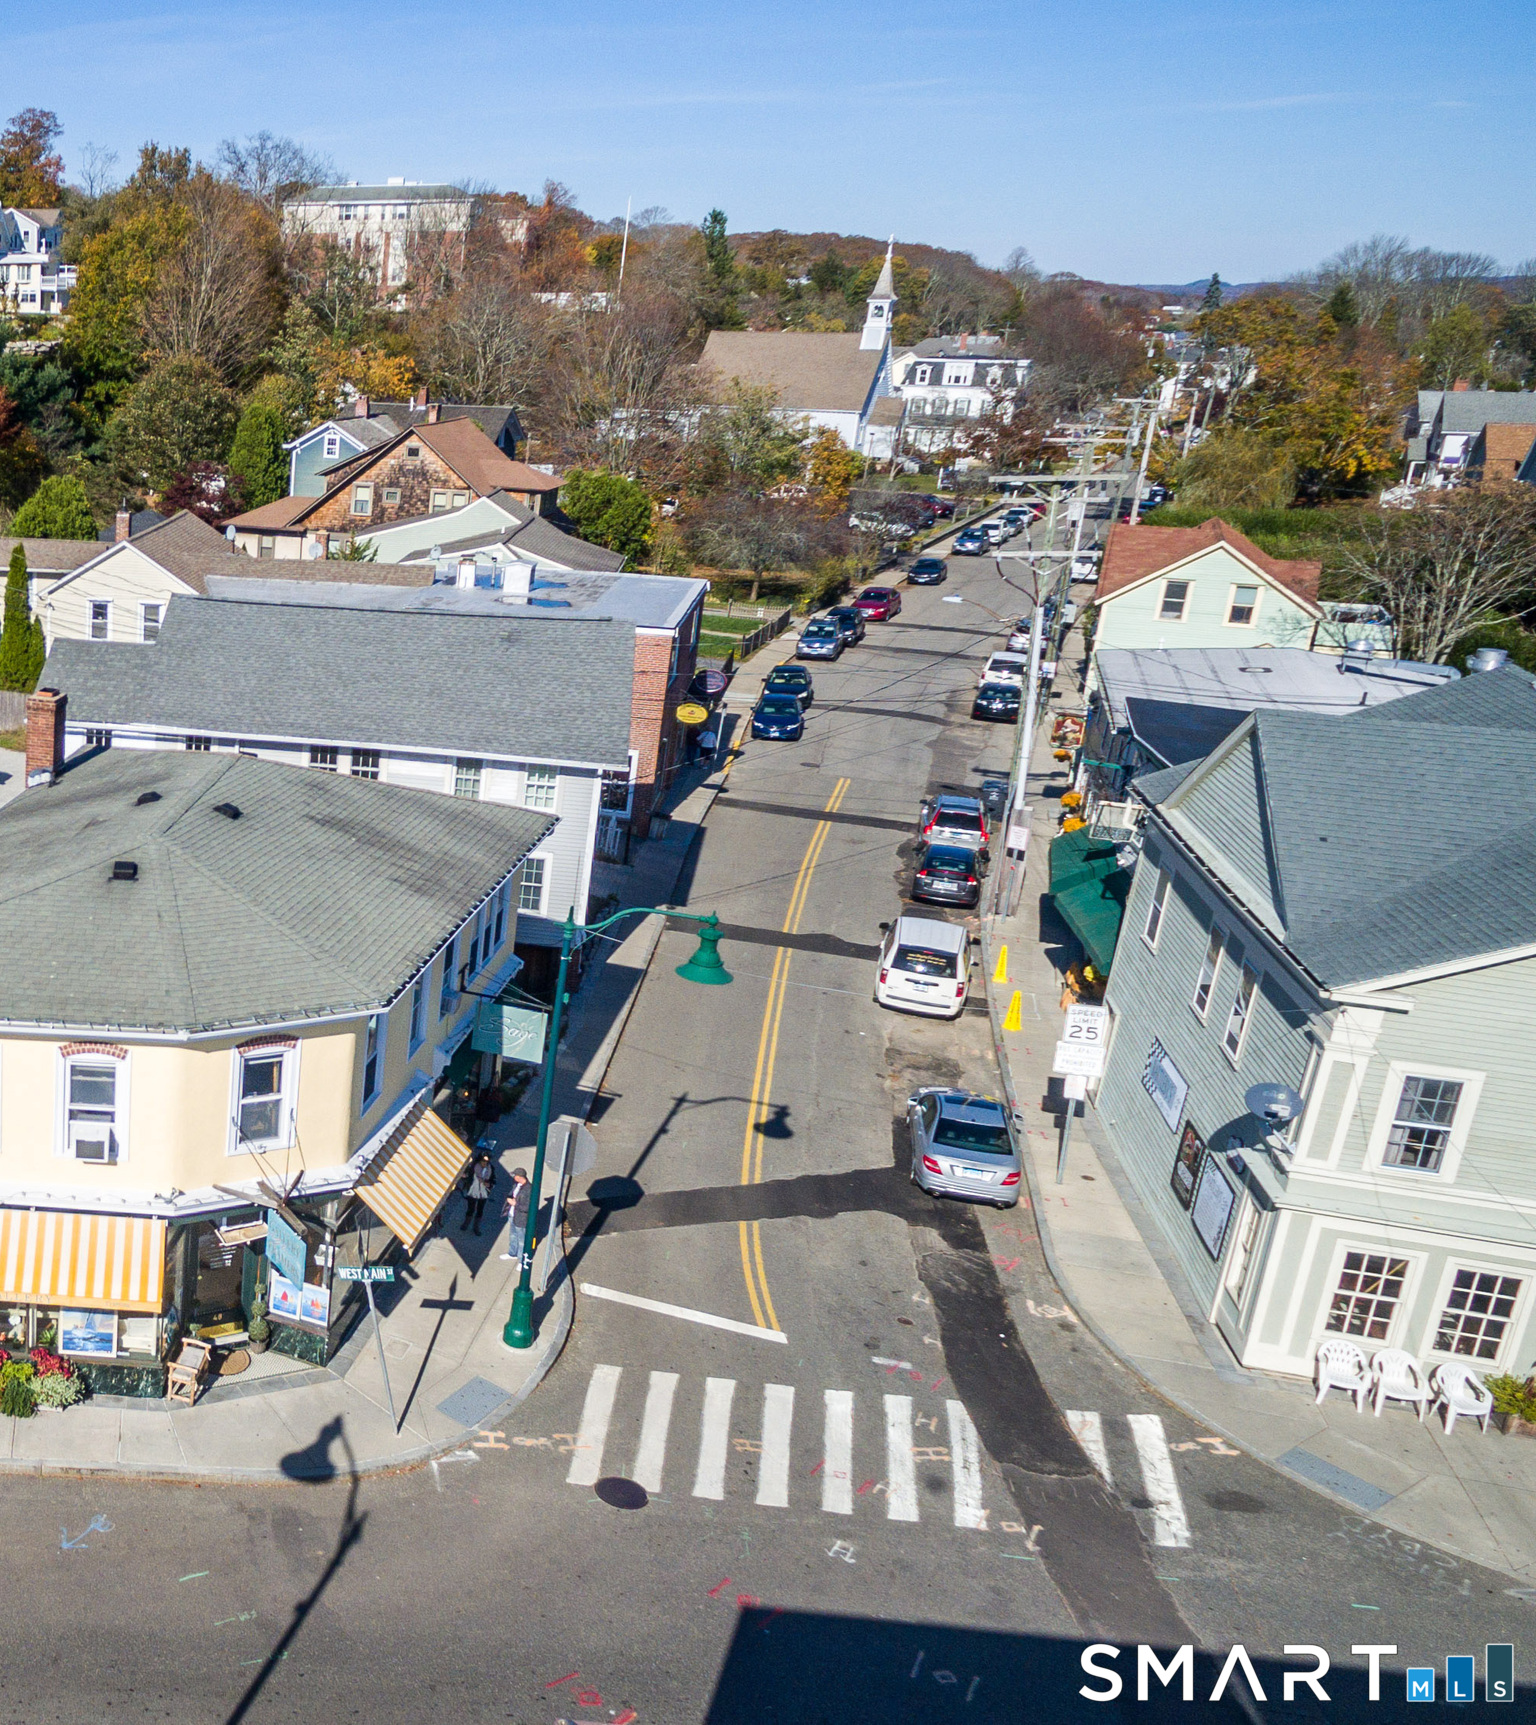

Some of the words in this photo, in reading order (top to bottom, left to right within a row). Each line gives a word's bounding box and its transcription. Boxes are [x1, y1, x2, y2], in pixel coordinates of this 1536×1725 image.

[1071, 1008, 1103, 1018] SPEED
[1072, 1017, 1098, 1025] LIMIT
[478, 1015, 539, 1048] Sage
[1068, 1025, 1099, 1040] 25
[338, 1267, 362, 1279] WEST
